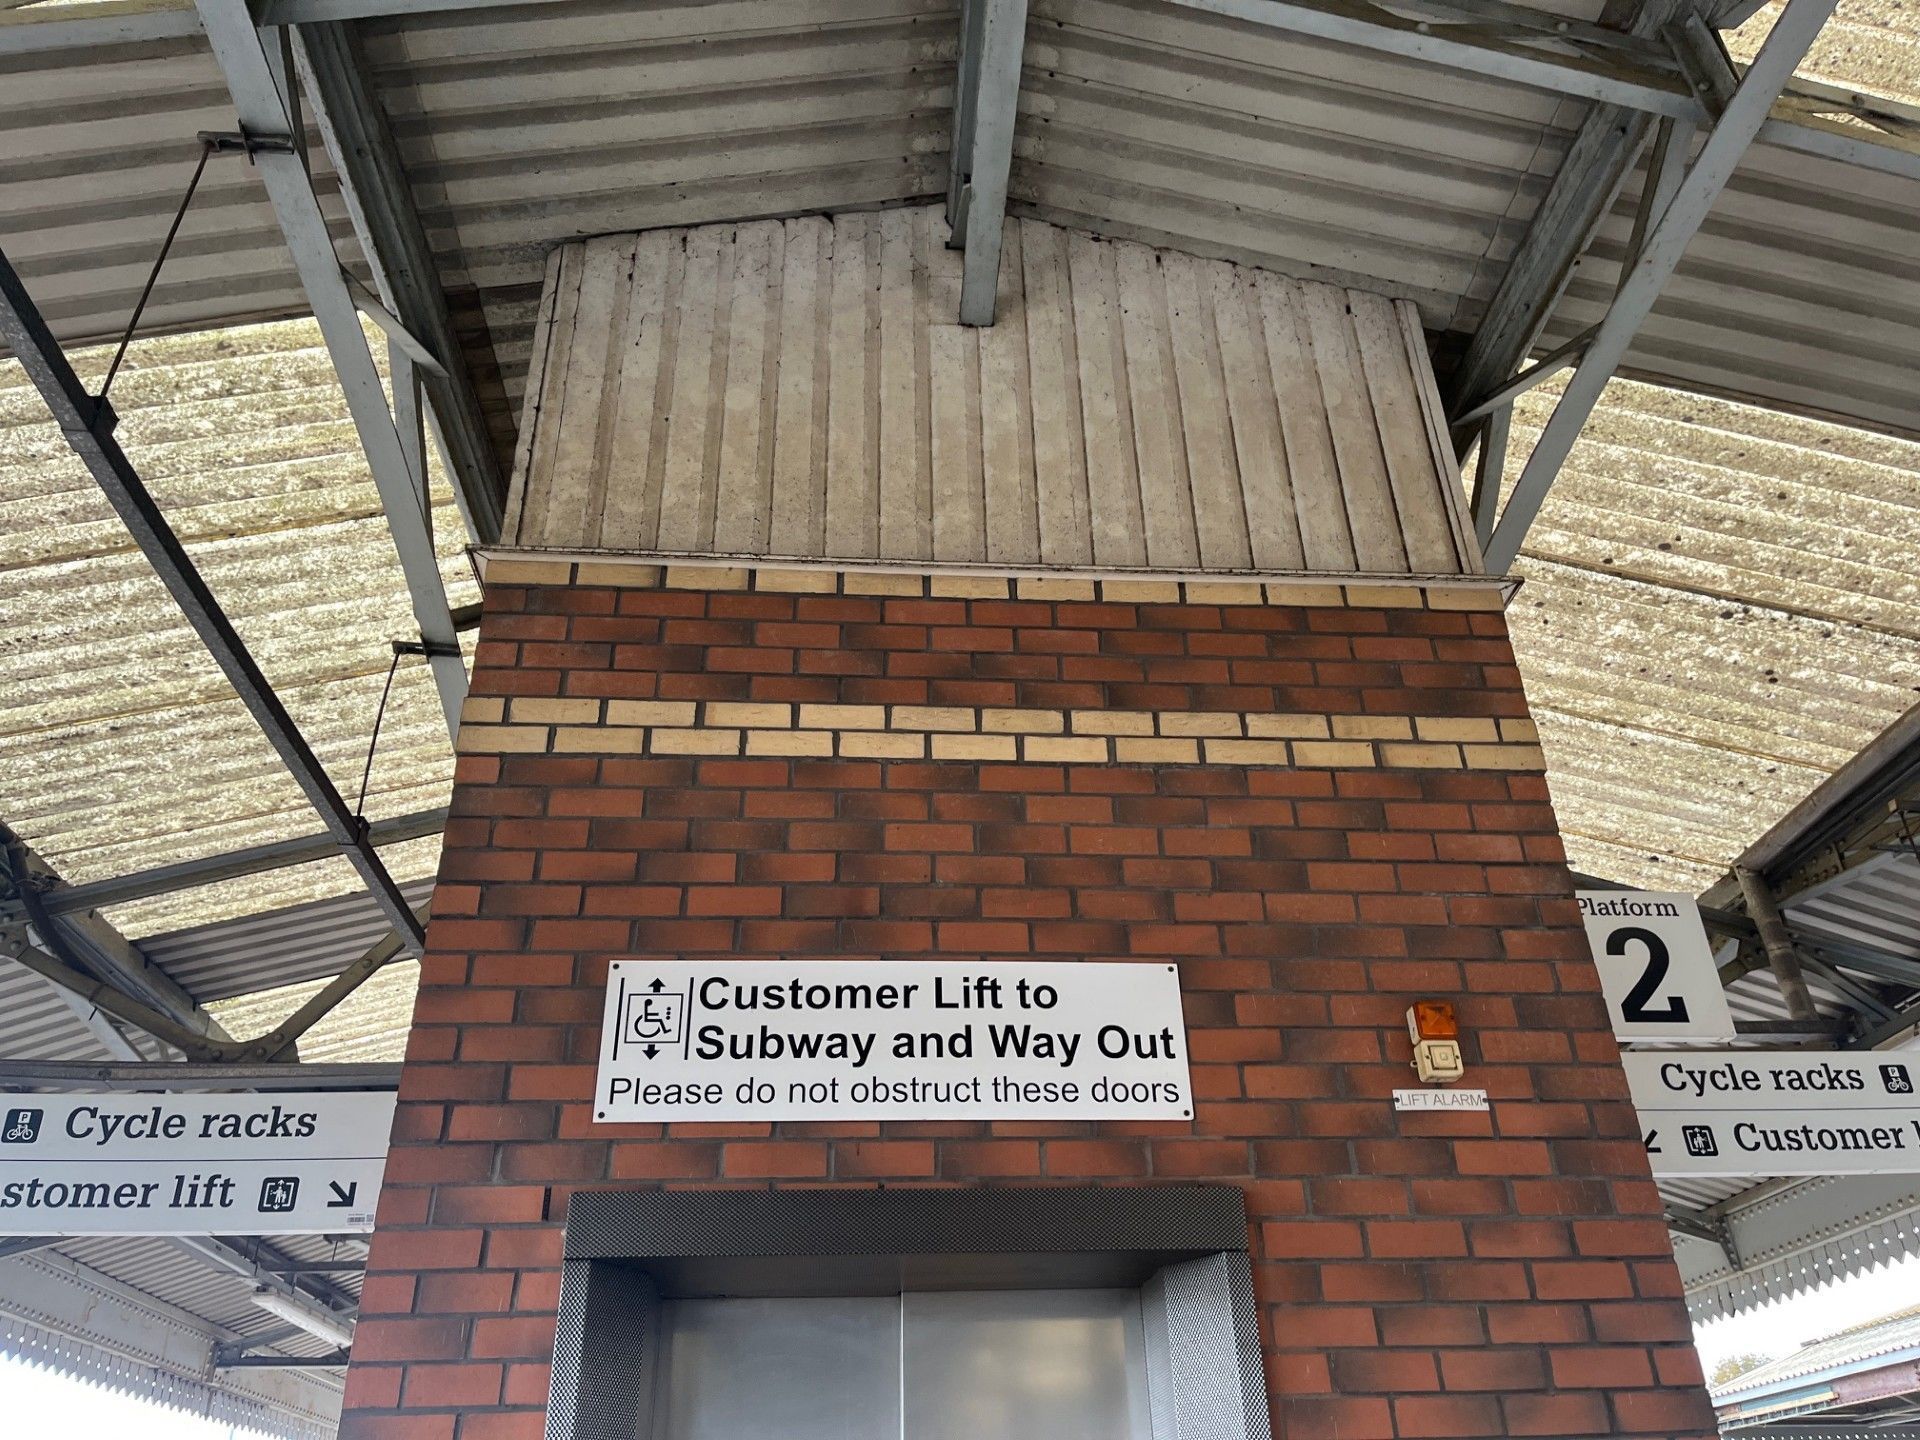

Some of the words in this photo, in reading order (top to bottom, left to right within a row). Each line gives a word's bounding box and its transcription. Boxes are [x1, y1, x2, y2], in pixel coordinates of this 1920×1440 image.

[1605, 926, 1690, 1023] 2
[699, 976, 919, 1011] Customer
[934, 976, 1003, 1009] Lift
[1015, 977, 1058, 1009] to
[695, 1024, 877, 1068] Subway
[892, 1024, 973, 1059] and
[988, 1024, 1081, 1068] Way
[1097, 1024, 1177, 1060] Out
[609, 1076, 723, 1106] Please
[735, 1076, 776, 1104] do
[789, 1077, 839, 1104] not
[850, 1075, 982, 1104] obstruct
[991, 1075, 1080, 1103] these
[1091, 1075, 1180, 1103] doors
[1660, 1062, 1762, 1098] Cycle
[1768, 1062, 1865, 1091] racks
[1400, 1093, 1428, 1107] LIFT
[1433, 1093, 1483, 1107] ALARM
[65, 1106, 187, 1146] Cycle
[198, 1105, 318, 1139] racks
[1733, 1122, 1906, 1152] Customer
[0, 1177, 160, 1209] stomer
[168, 1173, 236, 1209] lift
